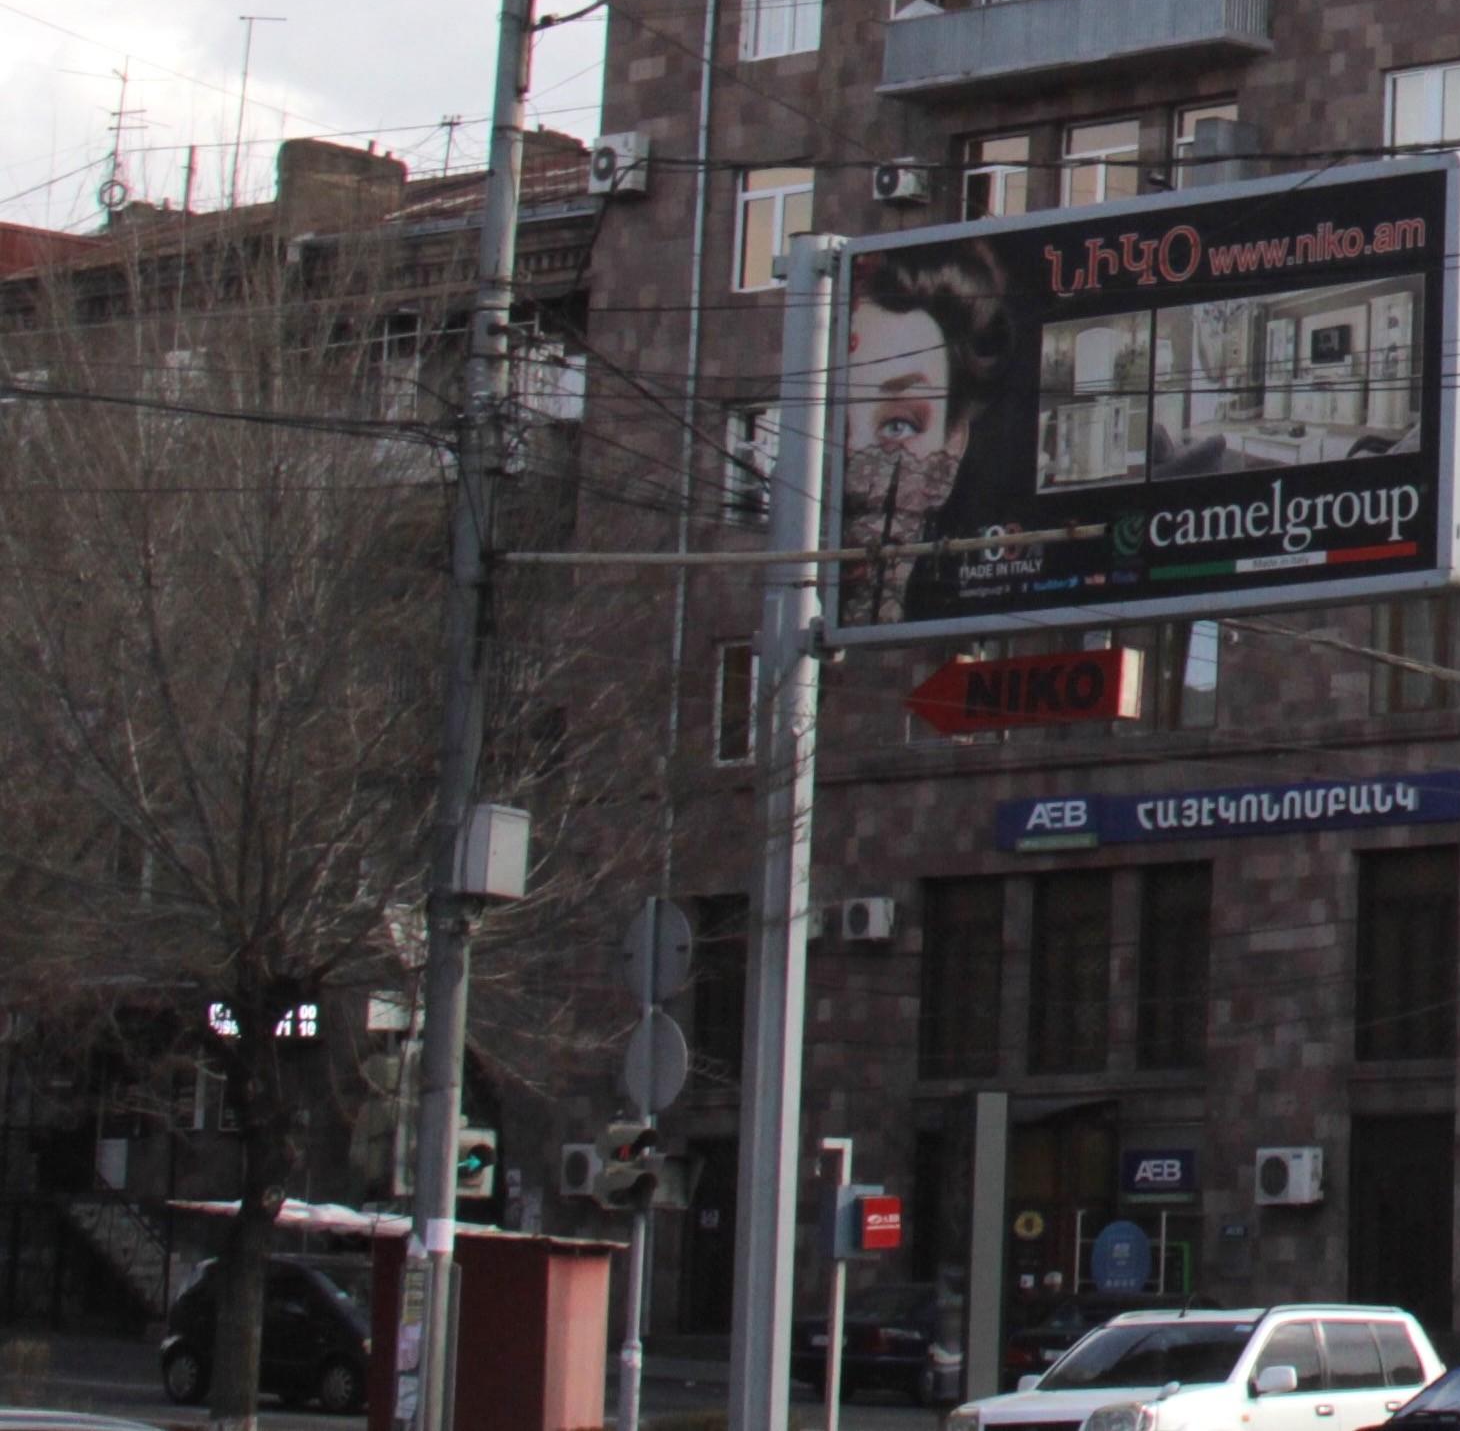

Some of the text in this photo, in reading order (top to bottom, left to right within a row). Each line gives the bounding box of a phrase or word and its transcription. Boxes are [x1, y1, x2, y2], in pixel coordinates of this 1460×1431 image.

[1209, 217, 1425, 276] www.niko.am
[1149, 479, 1419, 552] camelgroup
[958, 559, 1044, 579] MADE IN ITALY
[965, 660, 1105, 719] NIKO
[1026, 800, 1088, 831] AEB
[299, 1020, 318, 1037] 10
[1134, 1158, 1182, 1182] AEB
